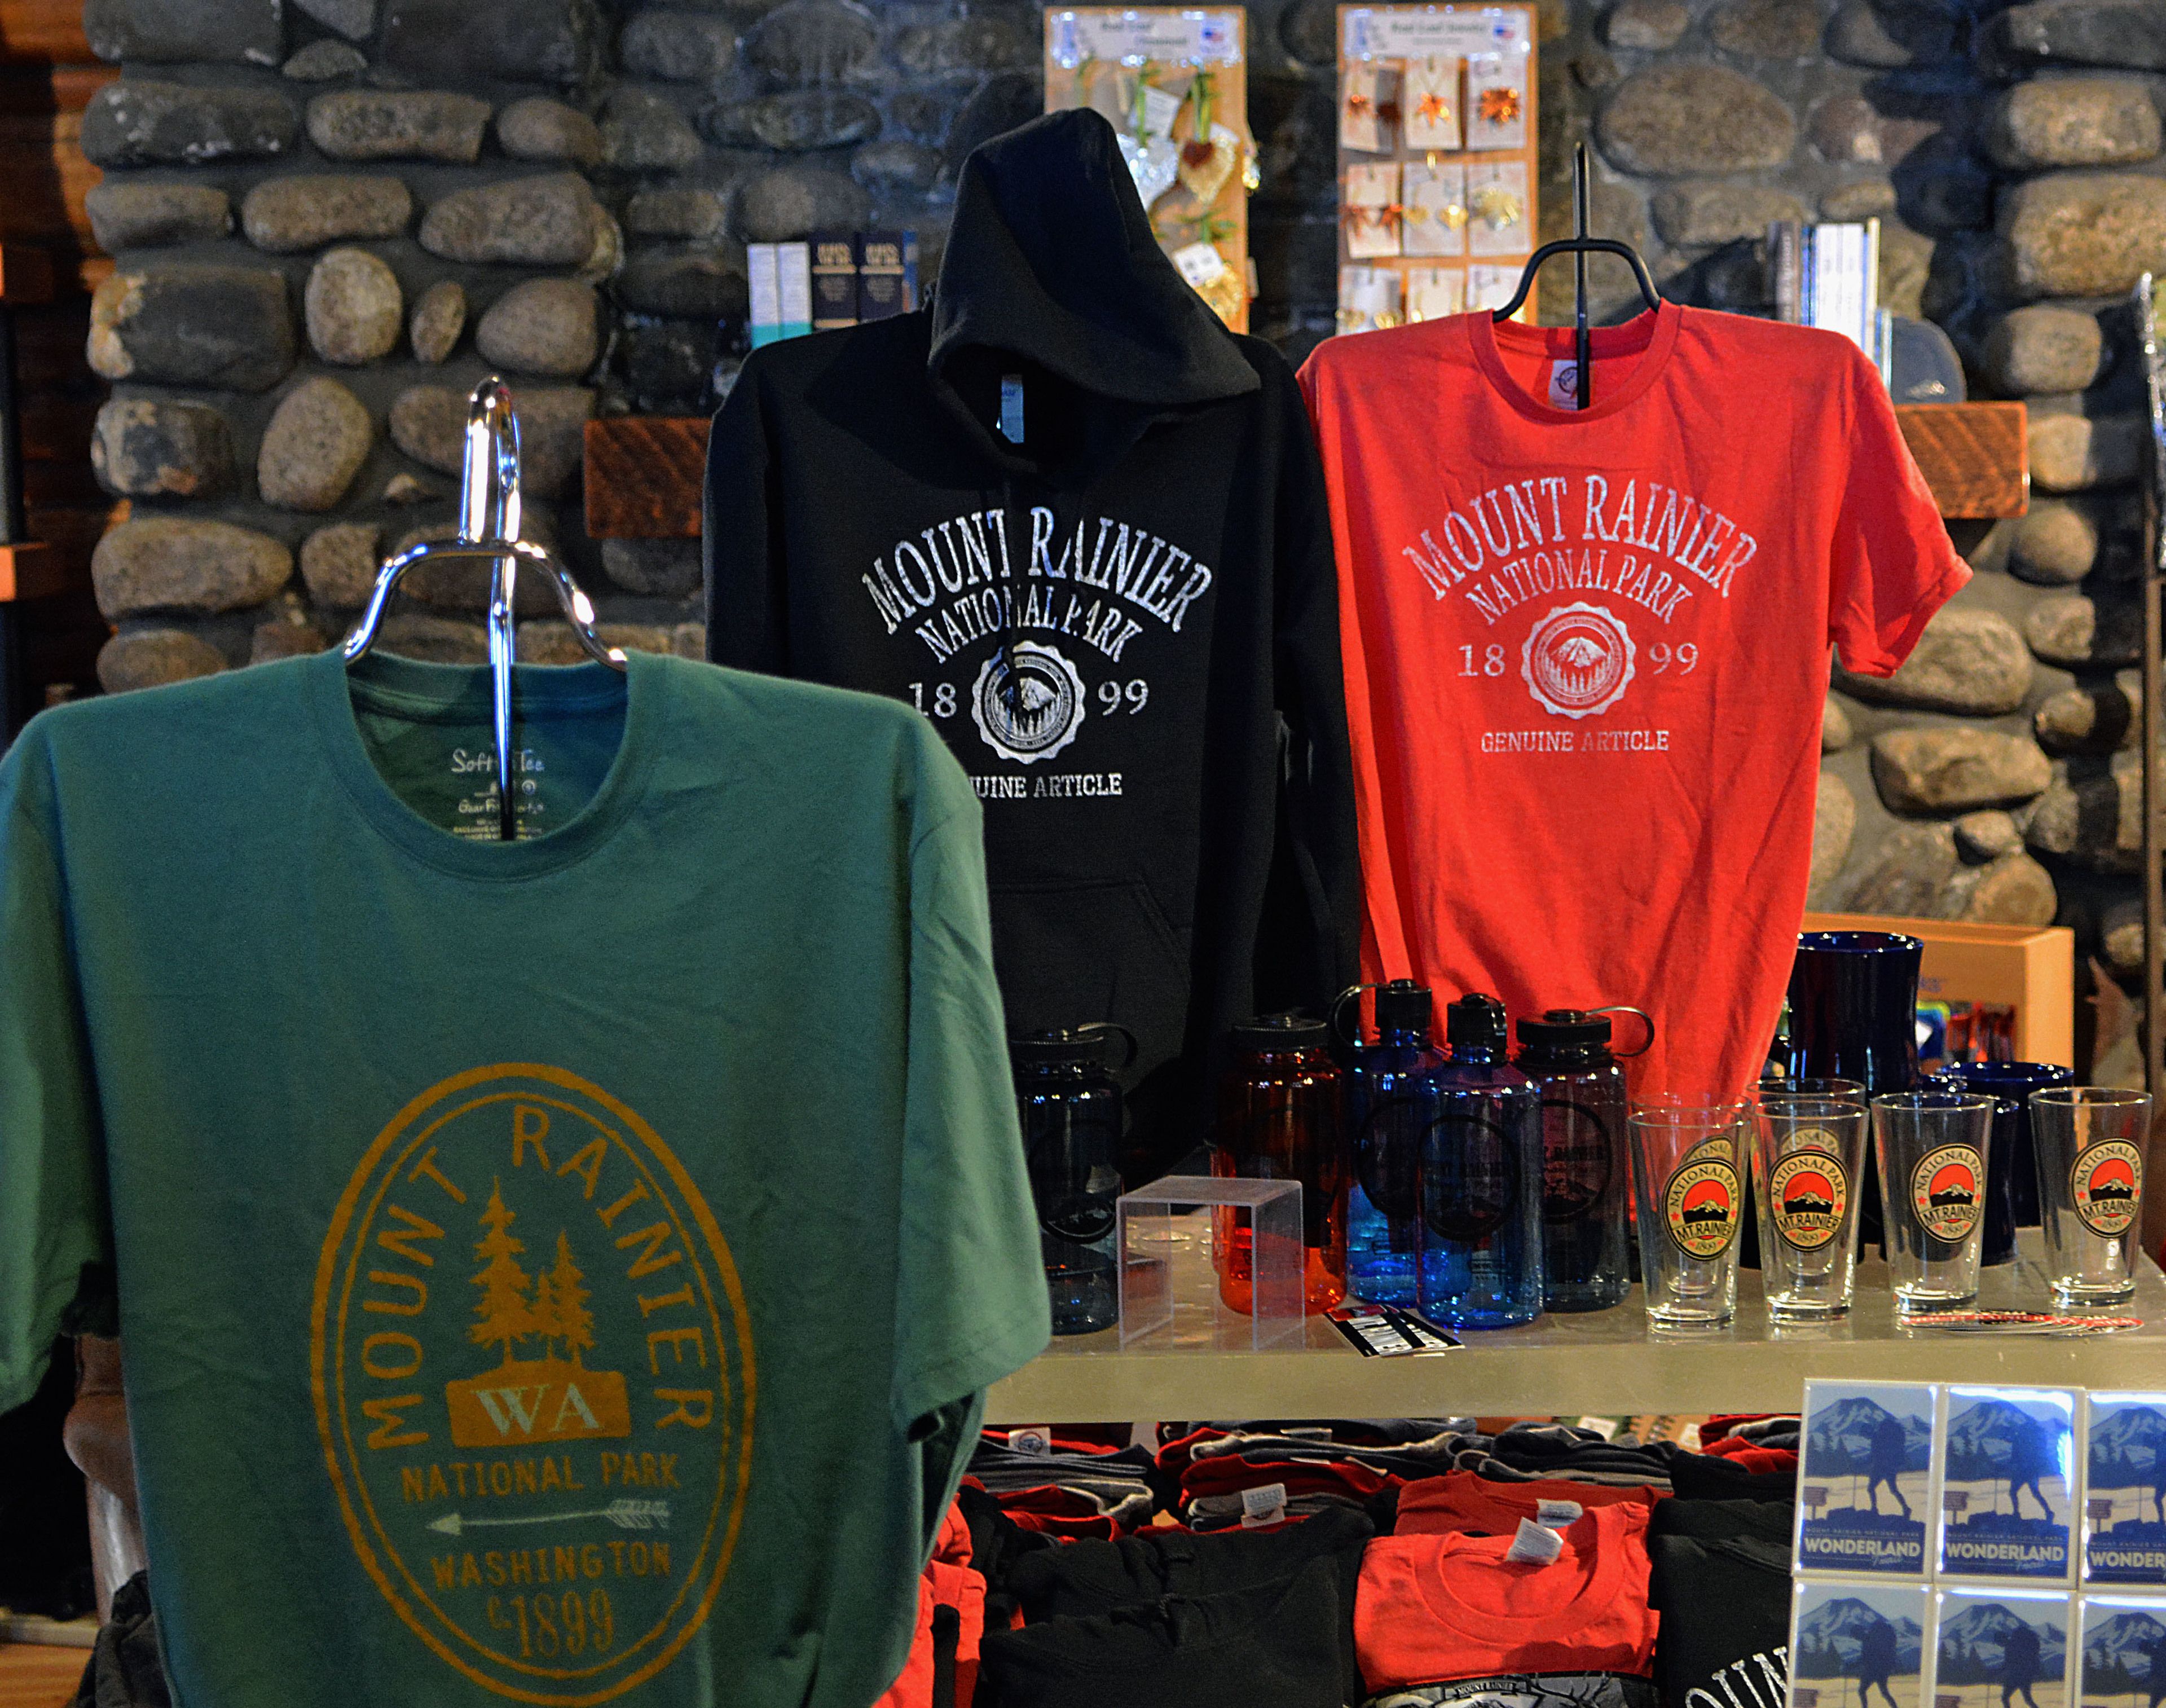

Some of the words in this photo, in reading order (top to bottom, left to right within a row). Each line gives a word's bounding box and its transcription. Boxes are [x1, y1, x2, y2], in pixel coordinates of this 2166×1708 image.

[1402, 477, 1568, 601] MOUNT
[1582, 474, 1758, 597] RAINIER
[862, 507, 1010, 635] MOUNT
[1028, 506, 1213, 633] RAINIER
[1465, 548, 1611, 626] NATIONAL
[1614, 554, 1693, 624] PARK
[915, 584, 1058, 664] NATIONAL
[1064, 593, 1143, 663] PARK
[1458, 644, 1506, 677] 18
[1649, 642, 1700, 675] 99
[909, 681, 957, 718] 18
[1098, 679, 1150, 716] 99
[1481, 731, 1573, 752] GENUINE
[1580, 730, 1670, 751] ARTICLE
[971, 776, 1027, 799] UINE
[1034, 773, 1122, 798] ARTICLE
[1669, 1165, 1723, 1207] NATIONAL
[1772, 1157, 1828, 1198] NATIONAL
[1828, 1168, 1846, 1197] PARK
[1916, 1151, 1971, 1191] NATIONAL
[2076, 1145, 2130, 1186] NATIONAL
[364, 1145, 467, 1451] MOUNT
[511, 1104, 715, 1430] RAINIER
[473, 1382, 606, 1437] WA
[401, 1455, 584, 1504] NATIONAL
[599, 1450, 681, 1489] PARK
[430, 1541, 672, 1590] WASHINGTON
[1804, 1538, 1921, 1557] WONDERLAND
[1946, 1542, 2064, 1562] WONDERLAND
[2090, 1551, 2166, 1568] WONDER
[510, 1588, 615, 1659] 1899
